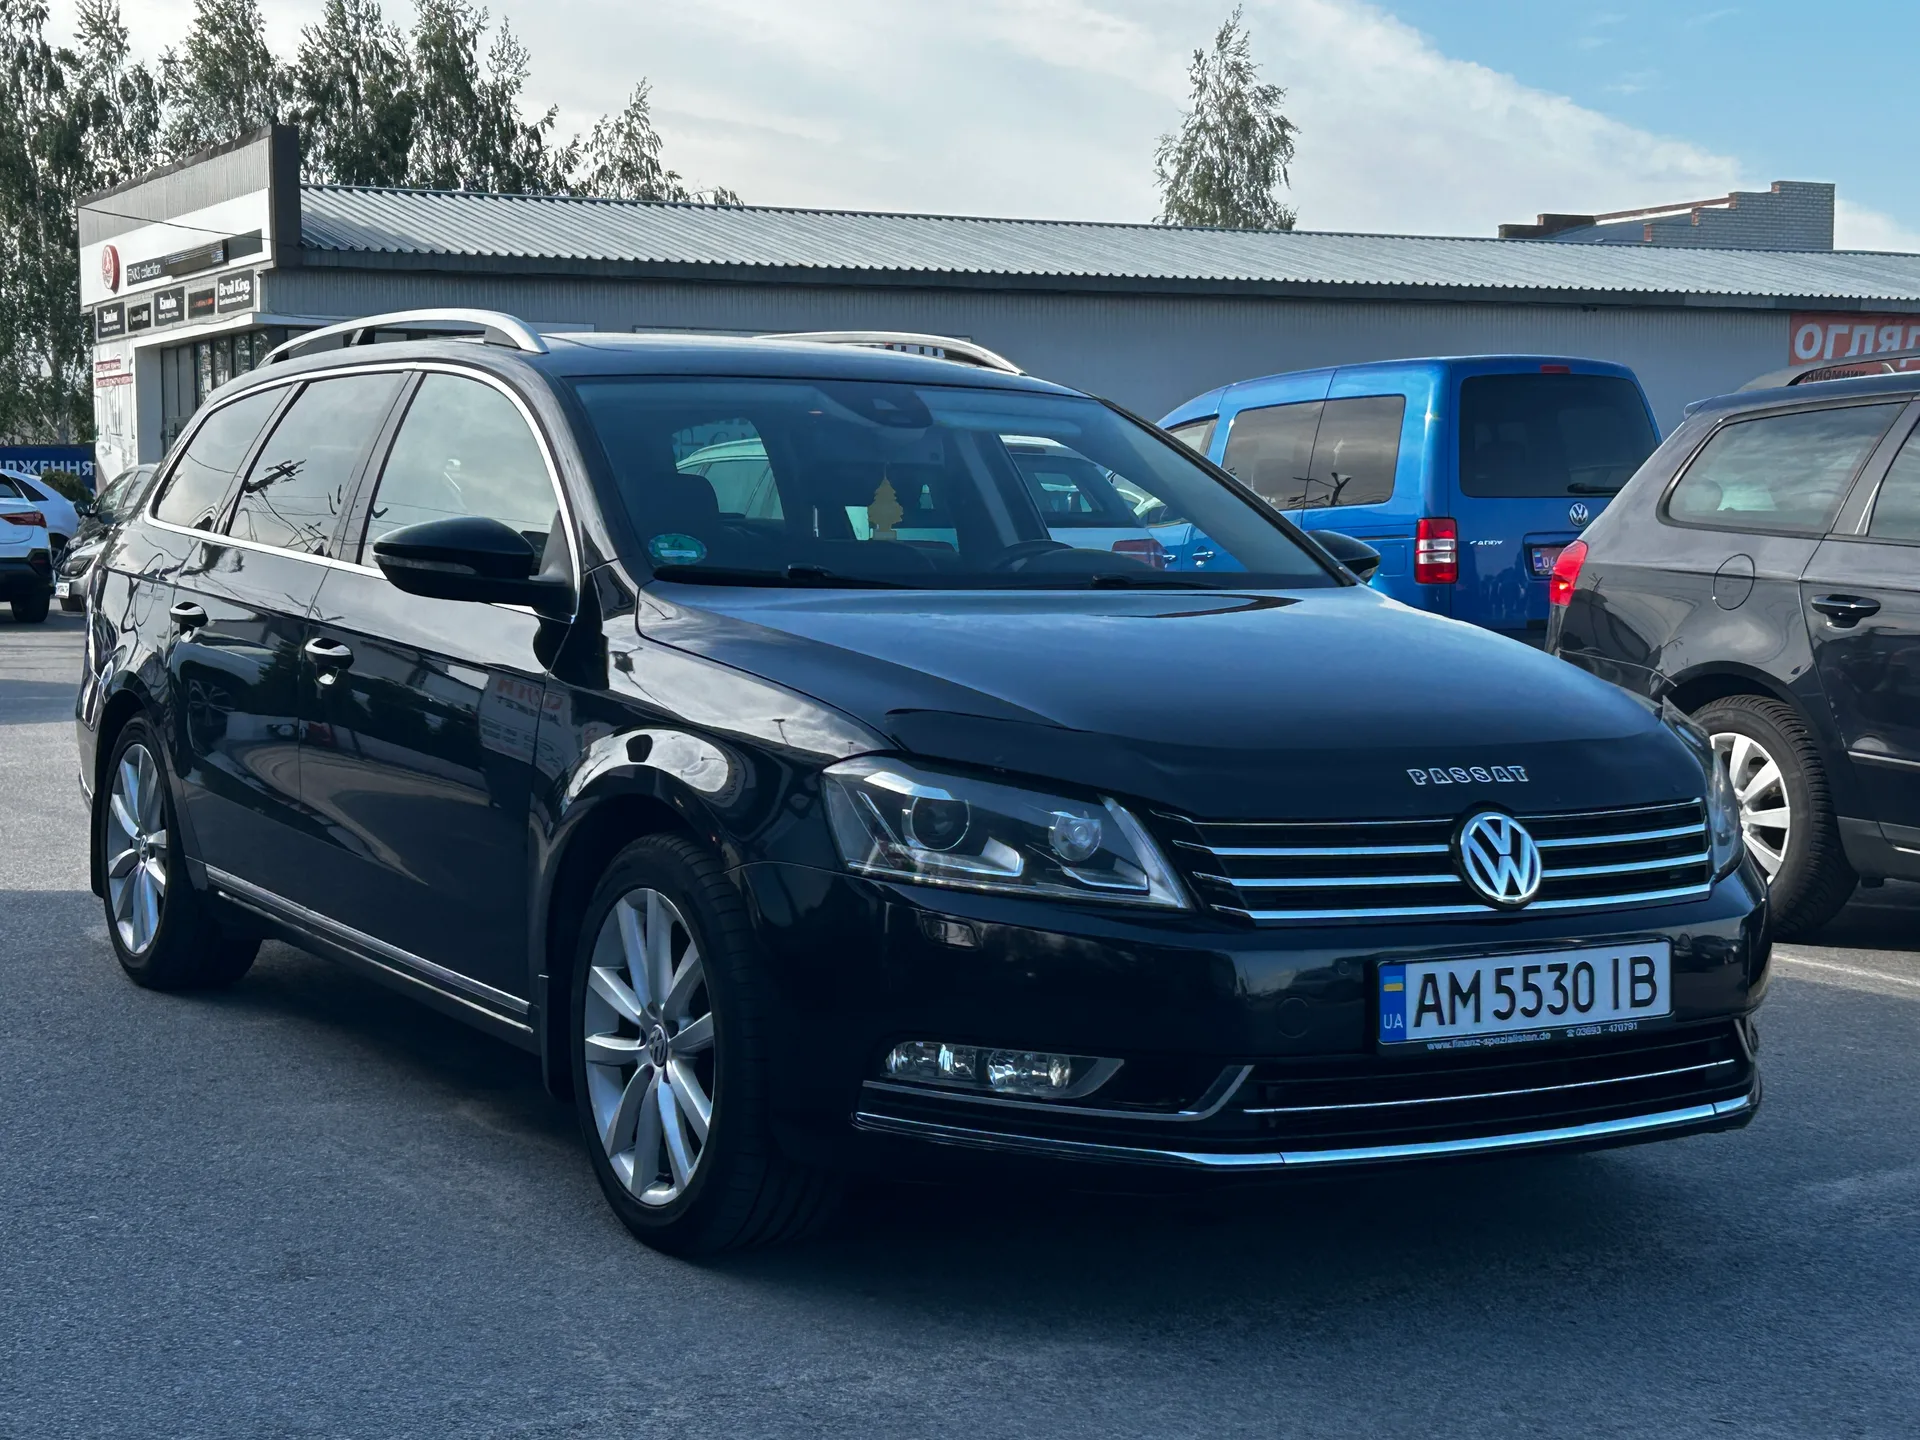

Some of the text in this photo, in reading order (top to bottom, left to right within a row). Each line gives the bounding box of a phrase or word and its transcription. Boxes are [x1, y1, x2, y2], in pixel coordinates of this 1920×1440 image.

[219, 277, 251, 297] Broil King
[0, 460, 94, 476] ДЖЕННЯ
[1407, 765, 1530, 785] PASSAT
[1413, 955, 1658, 1028] AM 5530 IB
[1383, 1012, 1404, 1030] UA
